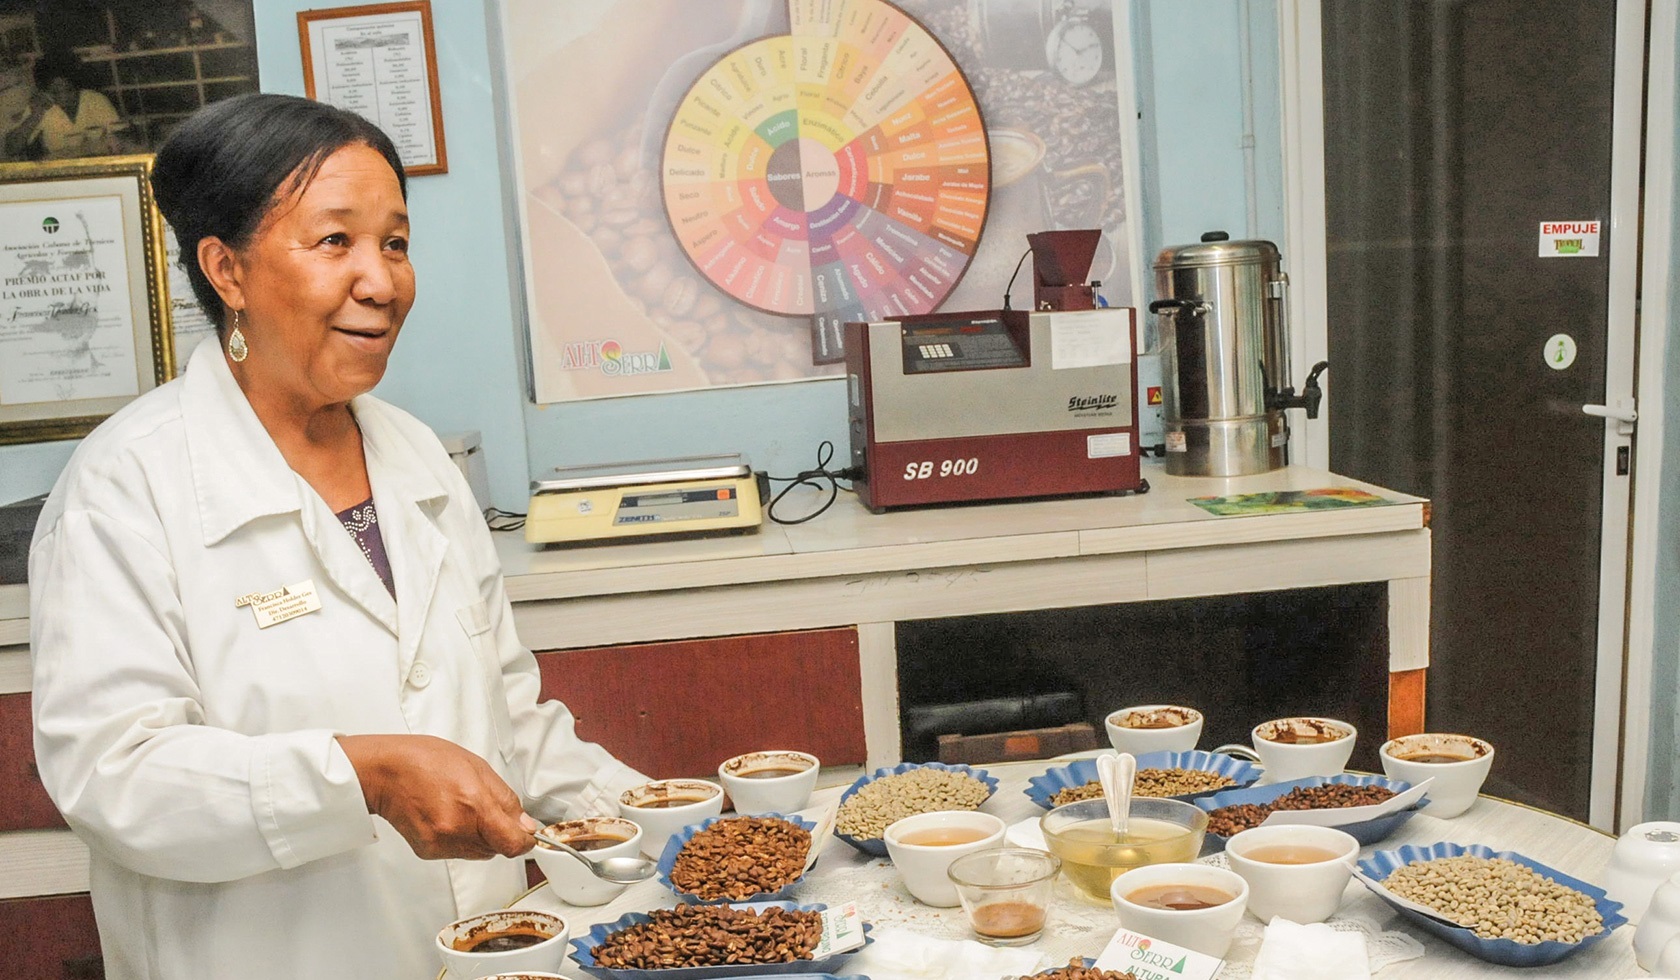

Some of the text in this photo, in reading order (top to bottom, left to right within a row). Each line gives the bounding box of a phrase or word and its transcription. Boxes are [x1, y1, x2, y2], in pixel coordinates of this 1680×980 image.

[800, 47, 808, 71] Floral
[669, 169, 705, 177] Delicado
[767, 172, 801, 181] Sabores
[805, 170, 836, 178] Aromas
[1543, 224, 1598, 234] EMPUJE
[5, 275, 47, 286] PREMIO
[85, 271, 106, 280] POR
[851, 264, 868, 288] Agudo
[2, 284, 111, 300] LA OBRA DE LA VIDA
[817, 274, 827, 303] Ceniza
[1068, 395, 1118, 411] Steinlite
[903, 458, 978, 481] SB 900
[618, 514, 655, 524] ZENITH
